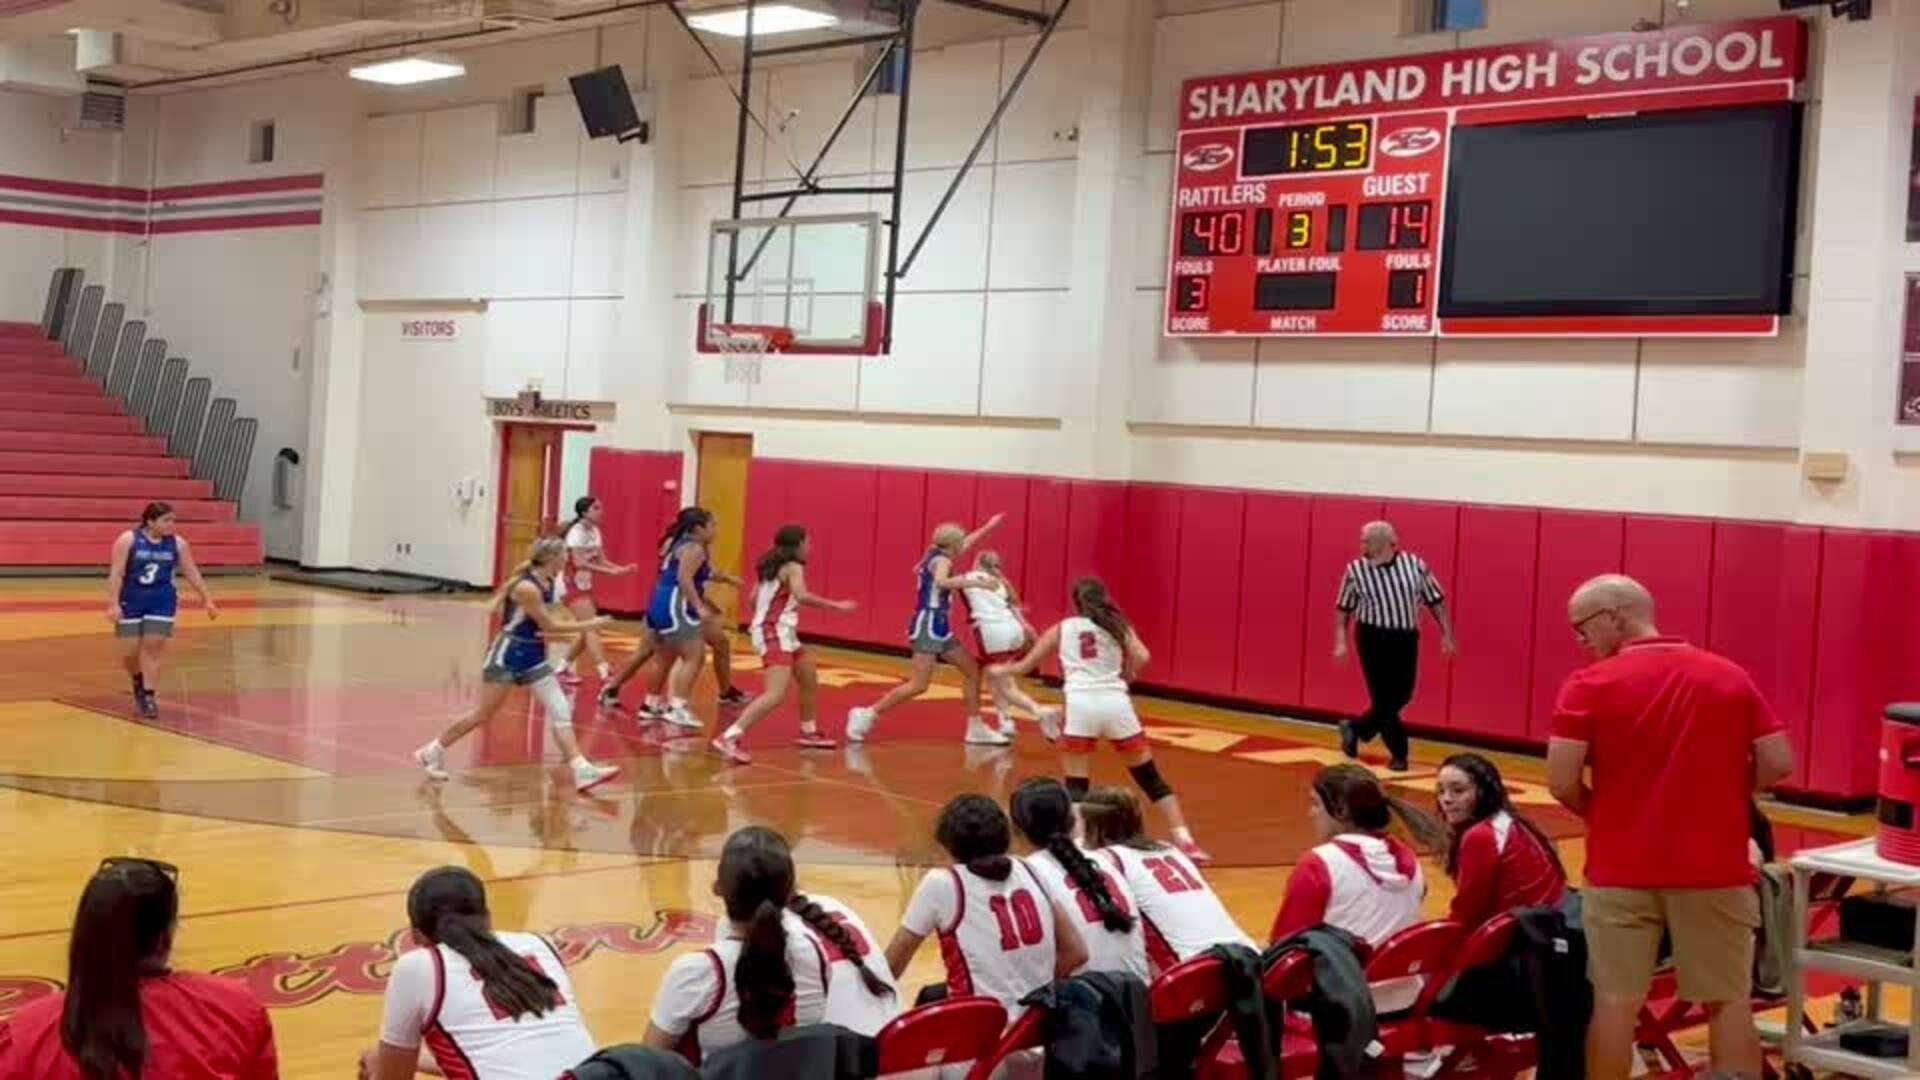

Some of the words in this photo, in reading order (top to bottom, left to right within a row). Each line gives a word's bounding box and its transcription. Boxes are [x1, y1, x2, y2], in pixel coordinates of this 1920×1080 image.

[1188, 64, 1426, 120] SHARYLAND
[1441, 51, 1558, 97] HIGH
[1575, 29, 1784, 85] SCHOOL
[1288, 123, 1369, 169] 1:53
[1179, 183, 1267, 208] RATTLERS
[1363, 173, 1431, 197] GUEST
[1279, 192, 1326, 207] PERIOD
[1193, 212, 1242, 254] 40
[1291, 213, 1310, 247] 3
[1388, 205, 1429, 245] 14
[1175, 260, 1214, 274] FOULS
[1257, 258, 1306, 272] PLAYER
[1308, 257, 1342, 271] FOUL
[1386, 254, 1432, 269] FOULS
[1189, 278, 1207, 309] 3
[1415, 275, 1424, 305] 1
[401, 320, 456, 337] VISITORS
[1171, 317, 1210, 331] SCORE
[1270, 316, 1316, 330] MATCH
[1382, 315, 1427, 330] SCORE
[139, 562, 160, 585] 3
[1079, 631, 1098, 660] 2
[1142, 855, 1204, 894] 21
[989, 887, 1044, 951] 10
